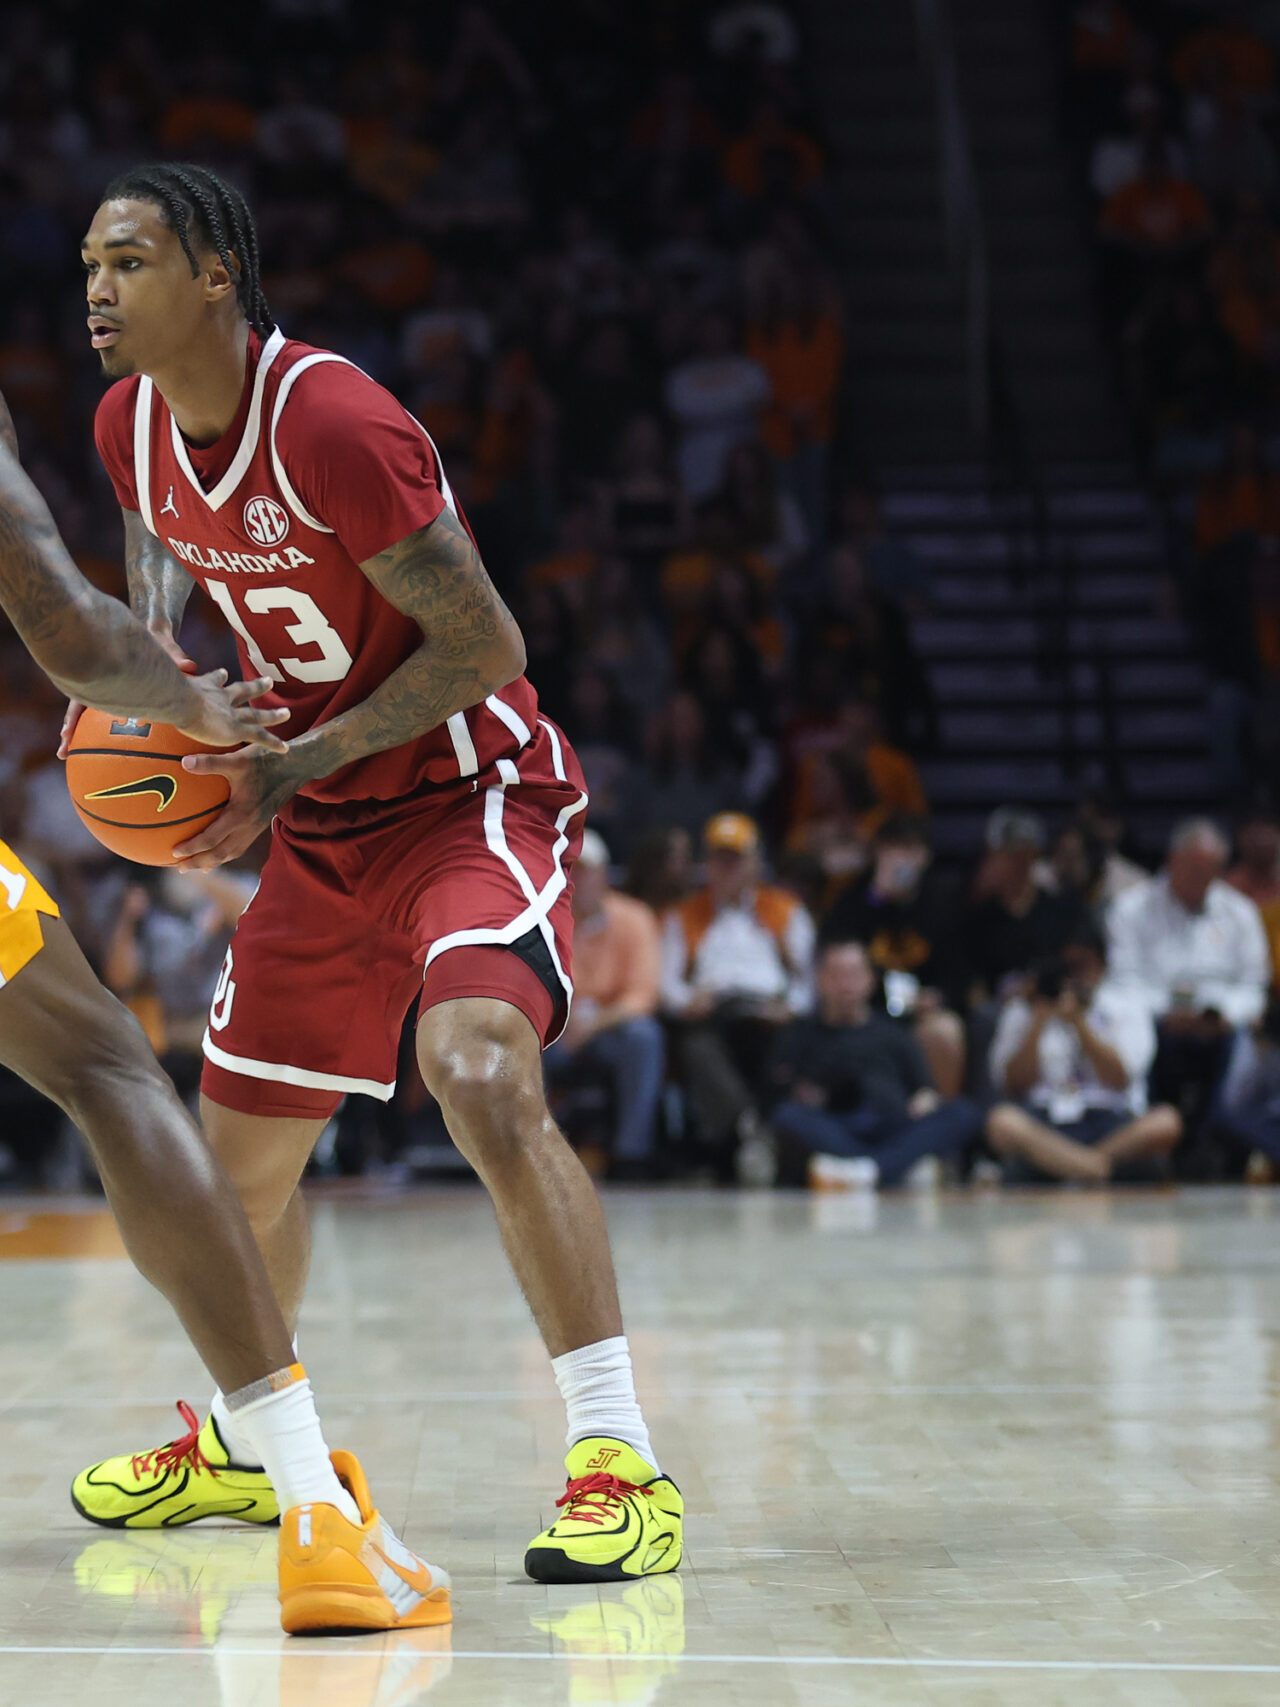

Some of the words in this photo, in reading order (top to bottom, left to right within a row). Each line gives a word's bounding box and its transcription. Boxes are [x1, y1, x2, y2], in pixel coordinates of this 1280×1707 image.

[245, 500, 286, 545] SEC
[168, 537, 315, 573] OKLAHOMA
[204, 577, 353, 683] 13
